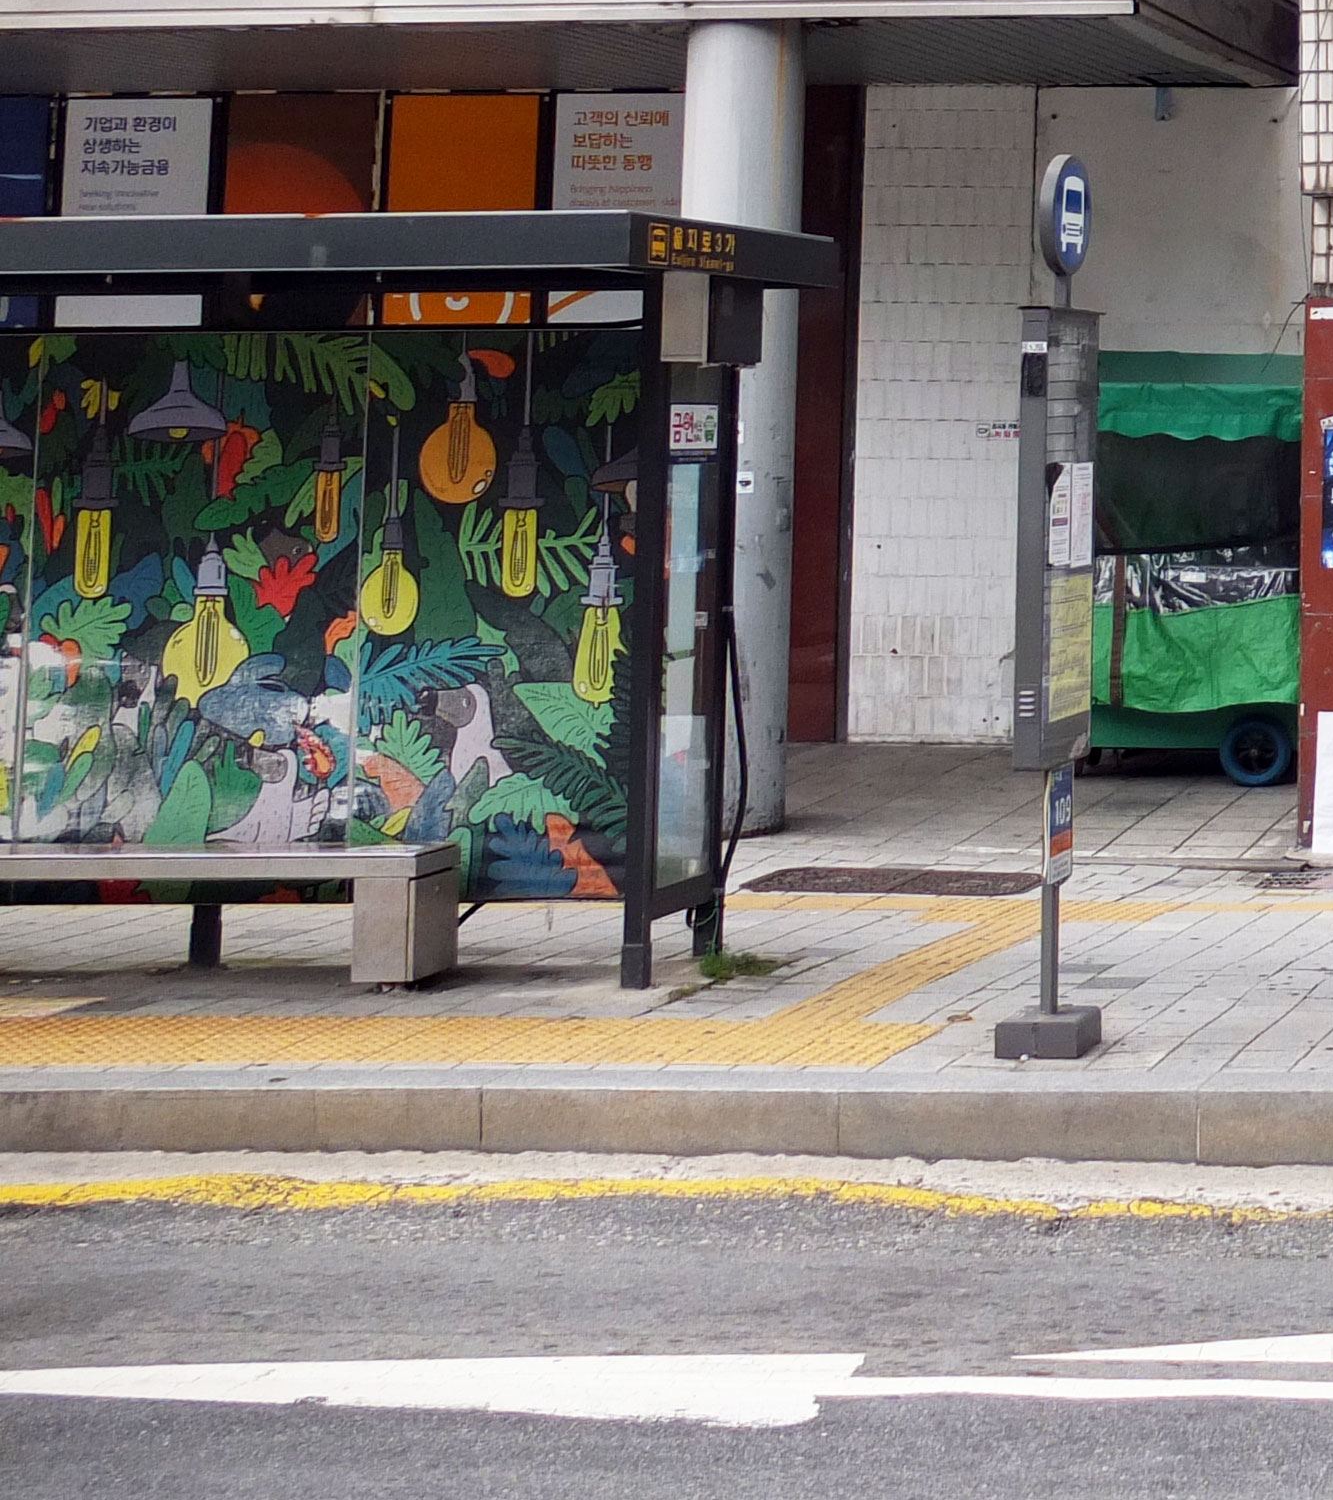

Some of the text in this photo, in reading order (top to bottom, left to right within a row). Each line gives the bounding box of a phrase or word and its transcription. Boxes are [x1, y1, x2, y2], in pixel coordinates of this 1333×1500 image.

[84, 116, 177, 132] 기업과 환경이
[573, 110, 670, 127] 고객의 신뢰에
[83, 138, 142, 154] 상생하는
[573, 133, 633, 149] 보답하는
[81, 159, 170, 176] 지속가능금융
[571, 155, 653, 171] 따뜻한 동행
[673, 226, 736, 256] 을지로3가
[672, 411, 694, 444] 금연
